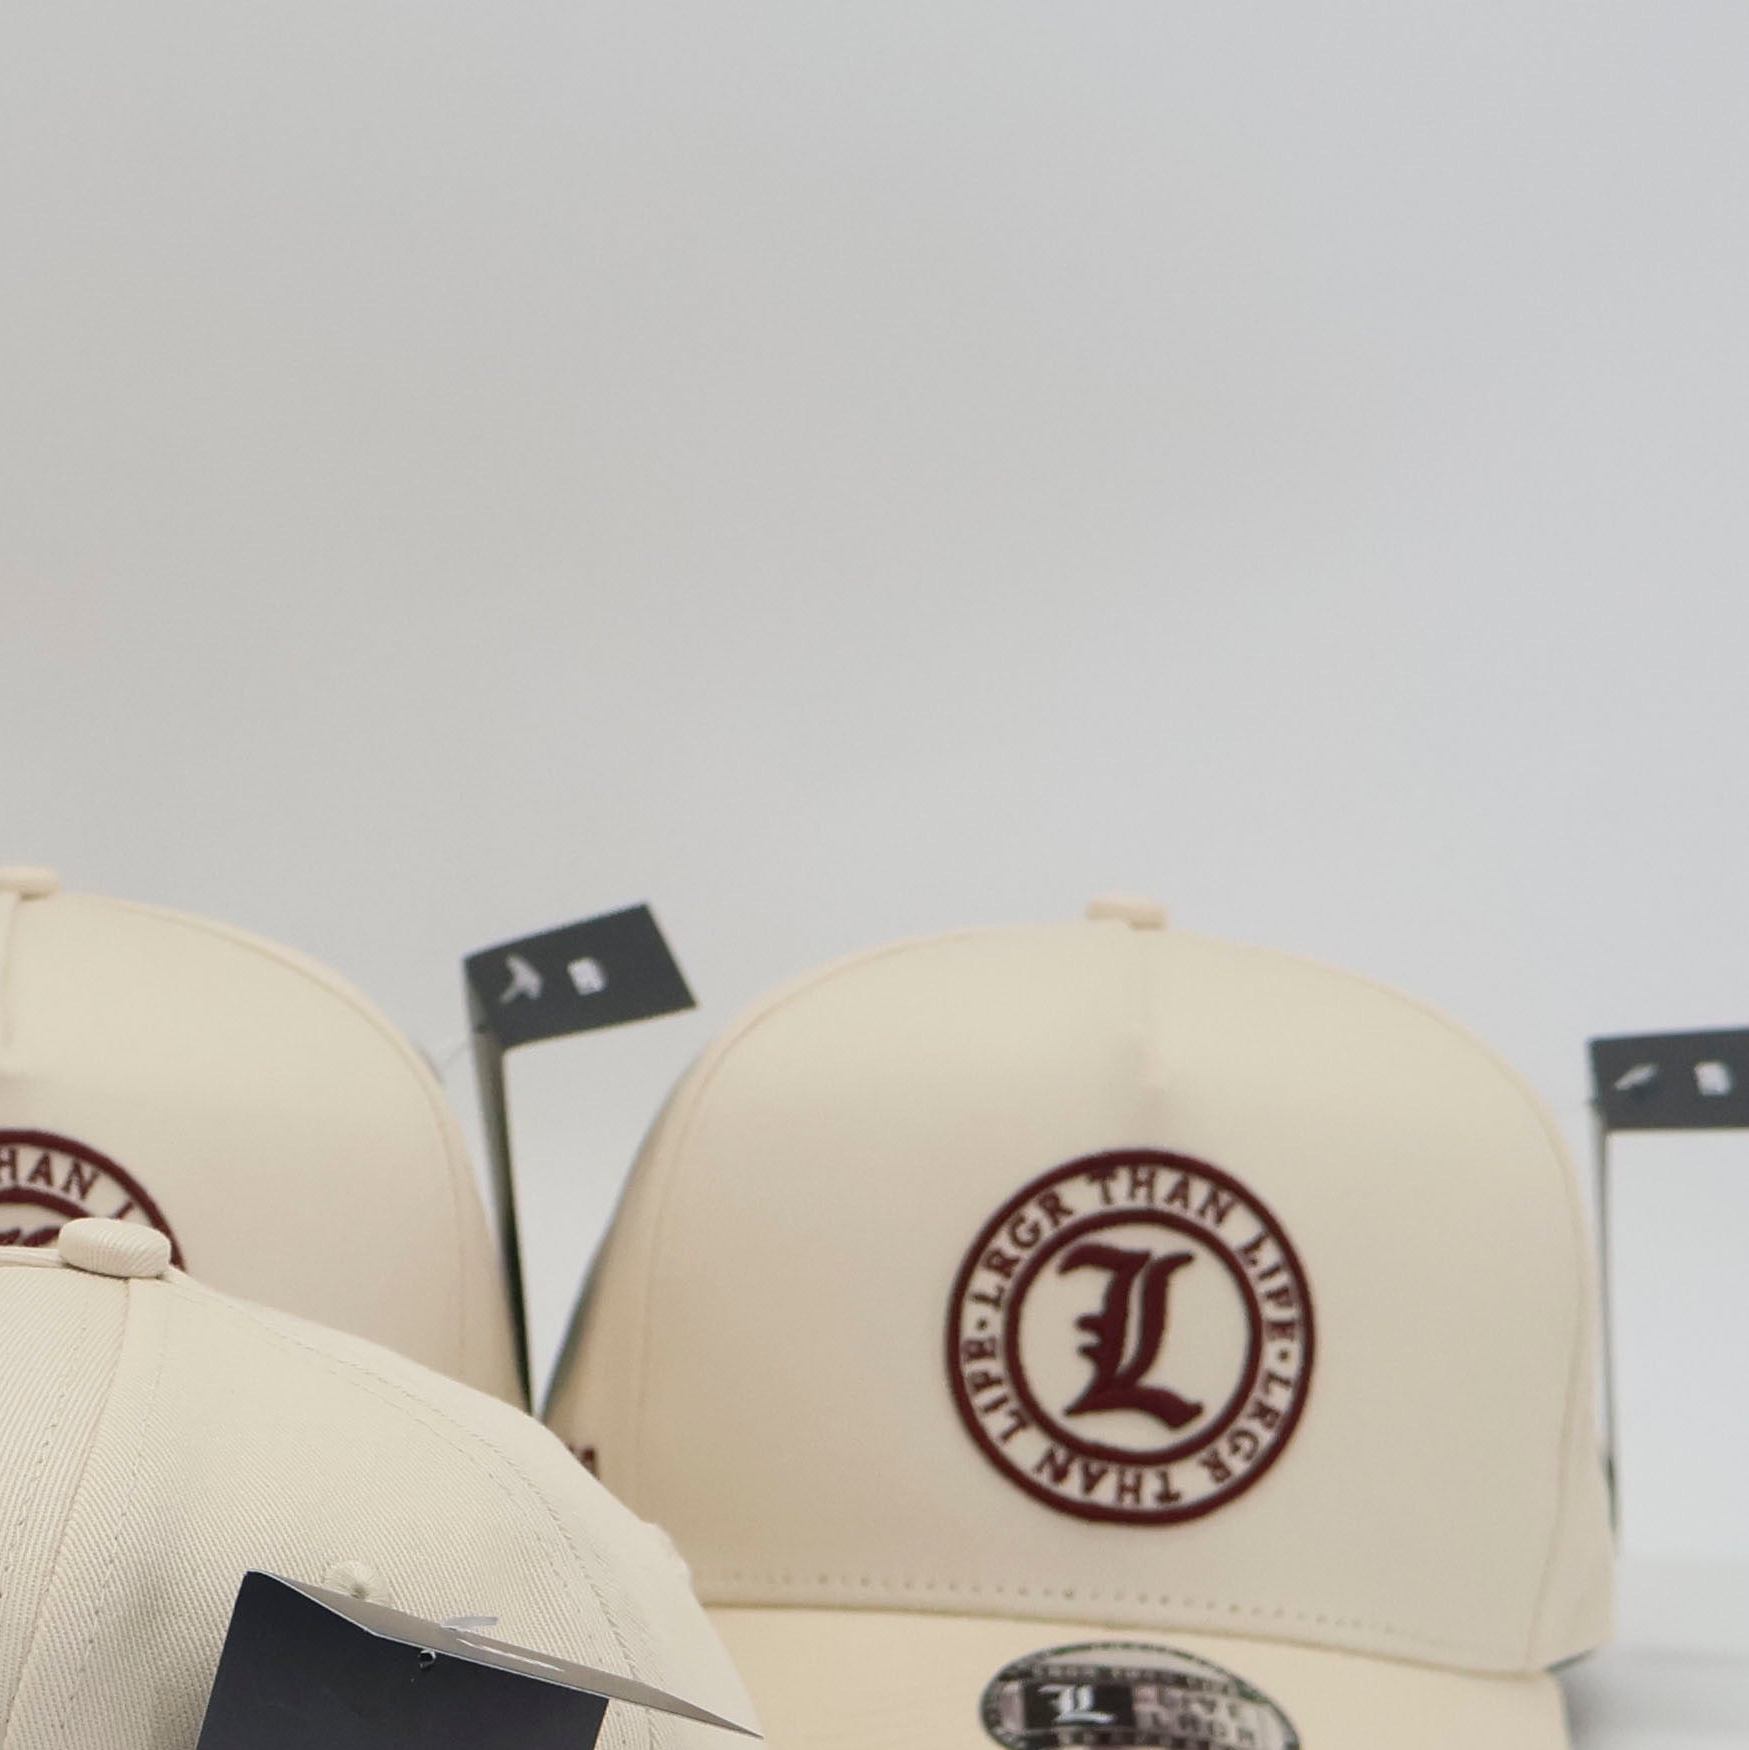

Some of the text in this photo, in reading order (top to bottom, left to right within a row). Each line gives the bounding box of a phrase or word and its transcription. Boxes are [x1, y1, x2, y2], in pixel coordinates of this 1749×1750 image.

[972, 1189, 1074, 1313] LRGR
[1086, 1164, 1238, 1228] THAN
[1057, 1241, 1204, 1431] L
[1032, 1448, 1182, 1506] THAN
[1198, 1367, 1292, 1484] LRGR
